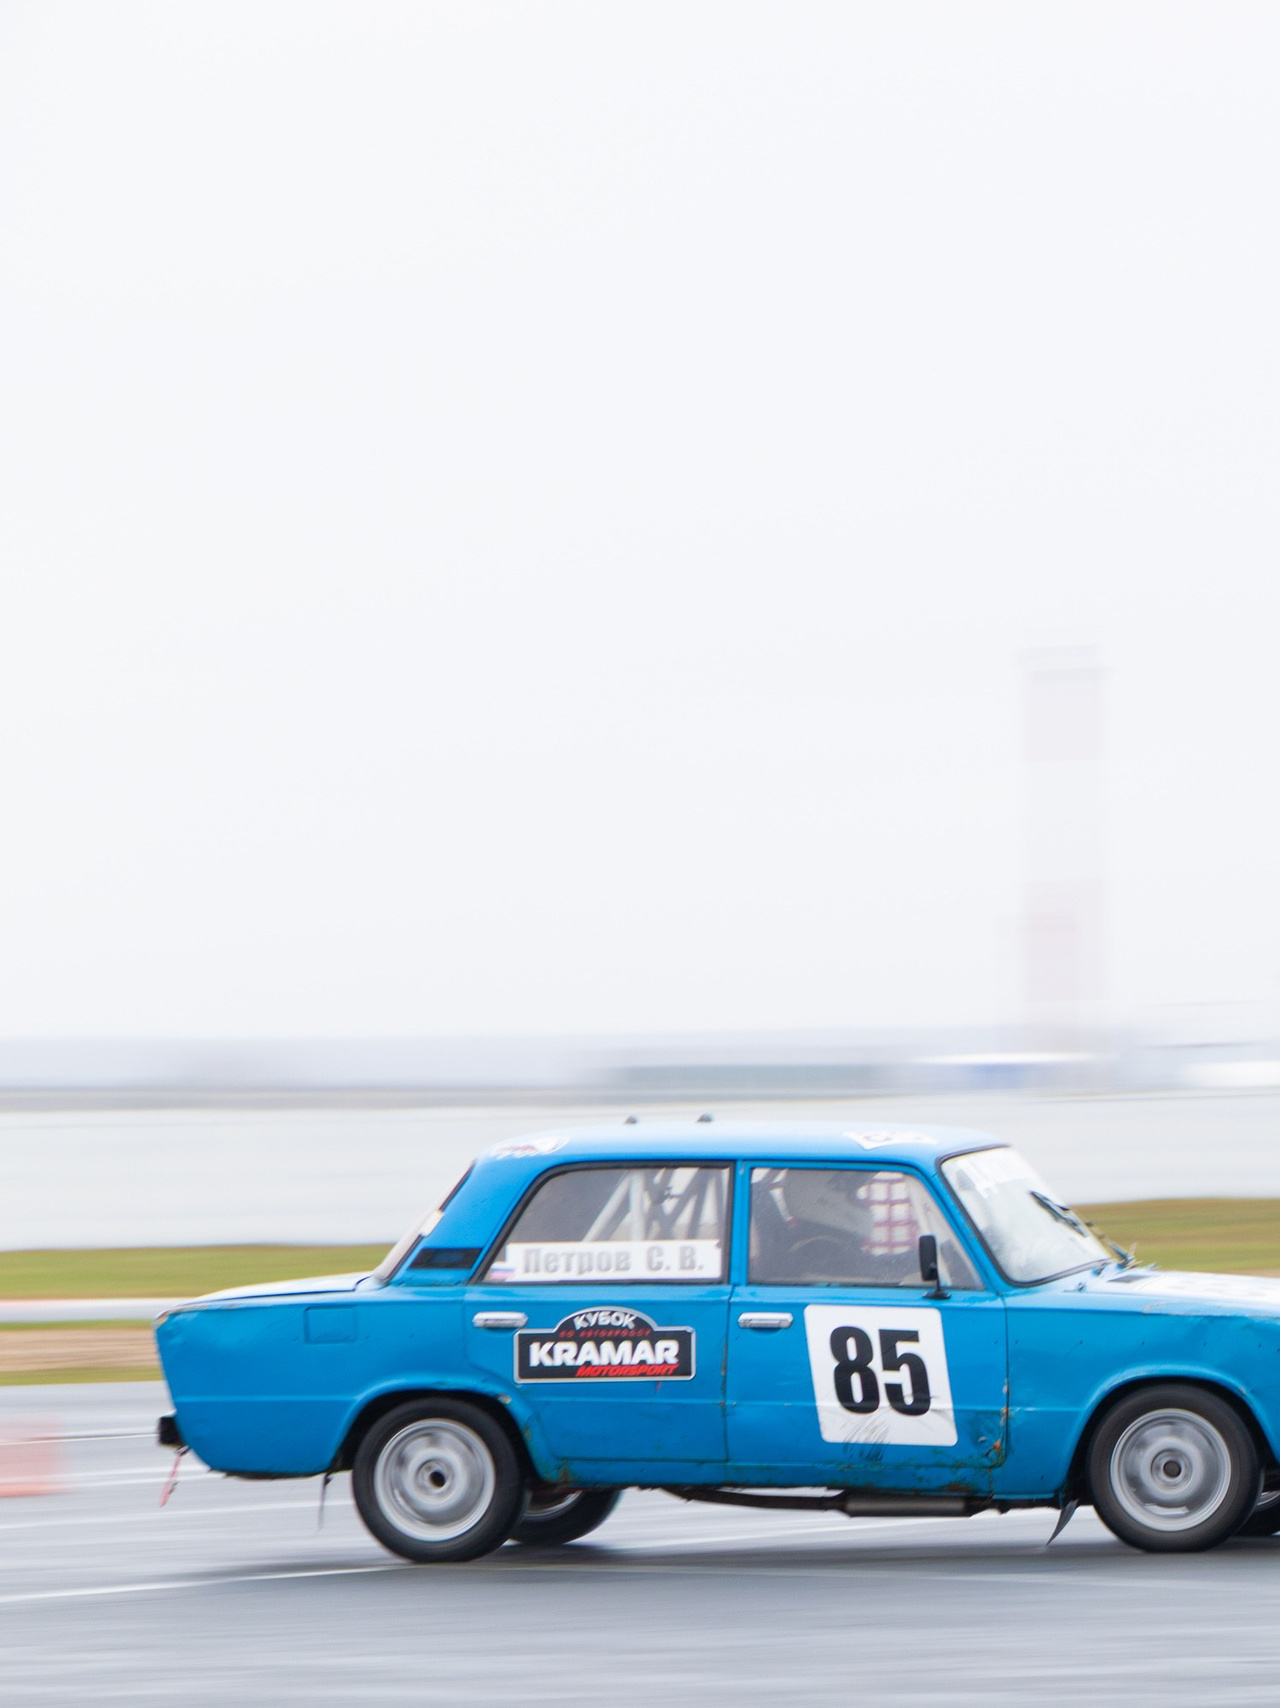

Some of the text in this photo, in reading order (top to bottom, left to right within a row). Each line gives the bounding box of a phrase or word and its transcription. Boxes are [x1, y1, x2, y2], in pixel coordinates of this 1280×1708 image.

[523, 1248, 631, 1275] Петров
[573, 1311, 637, 1330] КУБОК
[529, 1339, 680, 1367] KRAMAR
[576, 1364, 680, 1377] MOTORSPORT
[830, 1325, 931, 1416] 85
